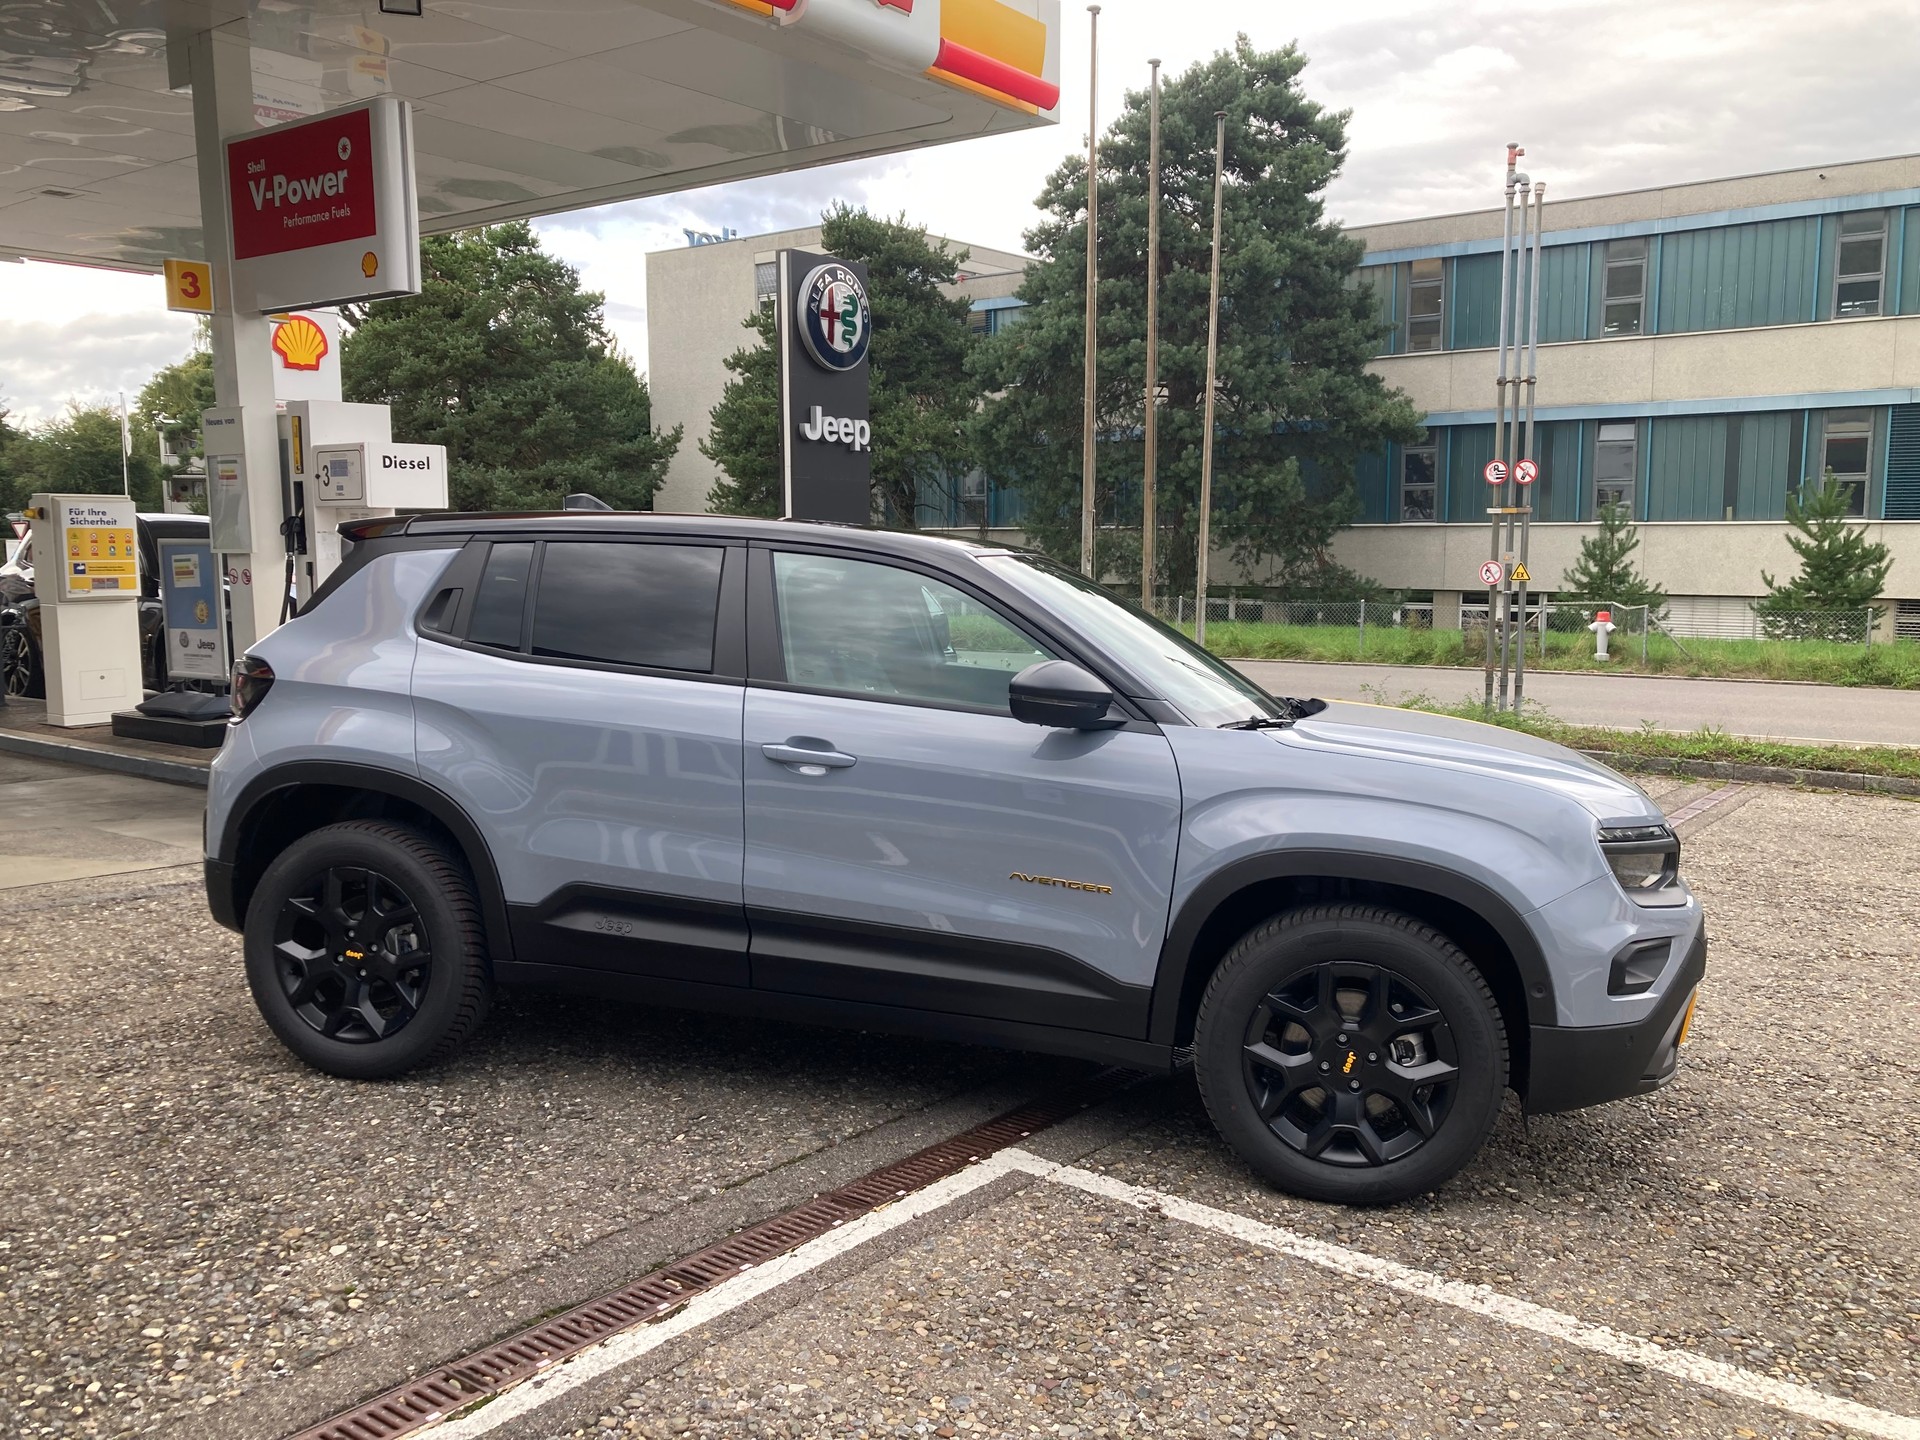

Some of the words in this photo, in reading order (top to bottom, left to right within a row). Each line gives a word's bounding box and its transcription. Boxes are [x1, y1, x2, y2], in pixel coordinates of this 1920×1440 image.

[247, 158, 266, 174] Shell
[248, 168, 348, 211] V-Power
[283, 211, 330, 229] Performance
[331, 203, 351, 219] Fuels
[180, 270, 201, 299] 3
[810, 273, 833, 314] ALFA
[836, 269, 869, 324] ROMEO
[205, 418, 224, 427] Neues
[224, 417, 235, 425] von
[382, 454, 430, 470] Diesel
[322, 464, 331, 487] 3
[68, 507, 85, 516] Für
[87, 507, 107, 517] Ihre
[69, 517, 117, 526] Sicherheit
[1516, 571, 1525, 579] EX
[197, 638, 216, 652] Jeep
[1009, 871, 1112, 895] AVENGER
[594, 916, 633, 935] Jeep
[1342, 1051, 1357, 1074] Jeep
